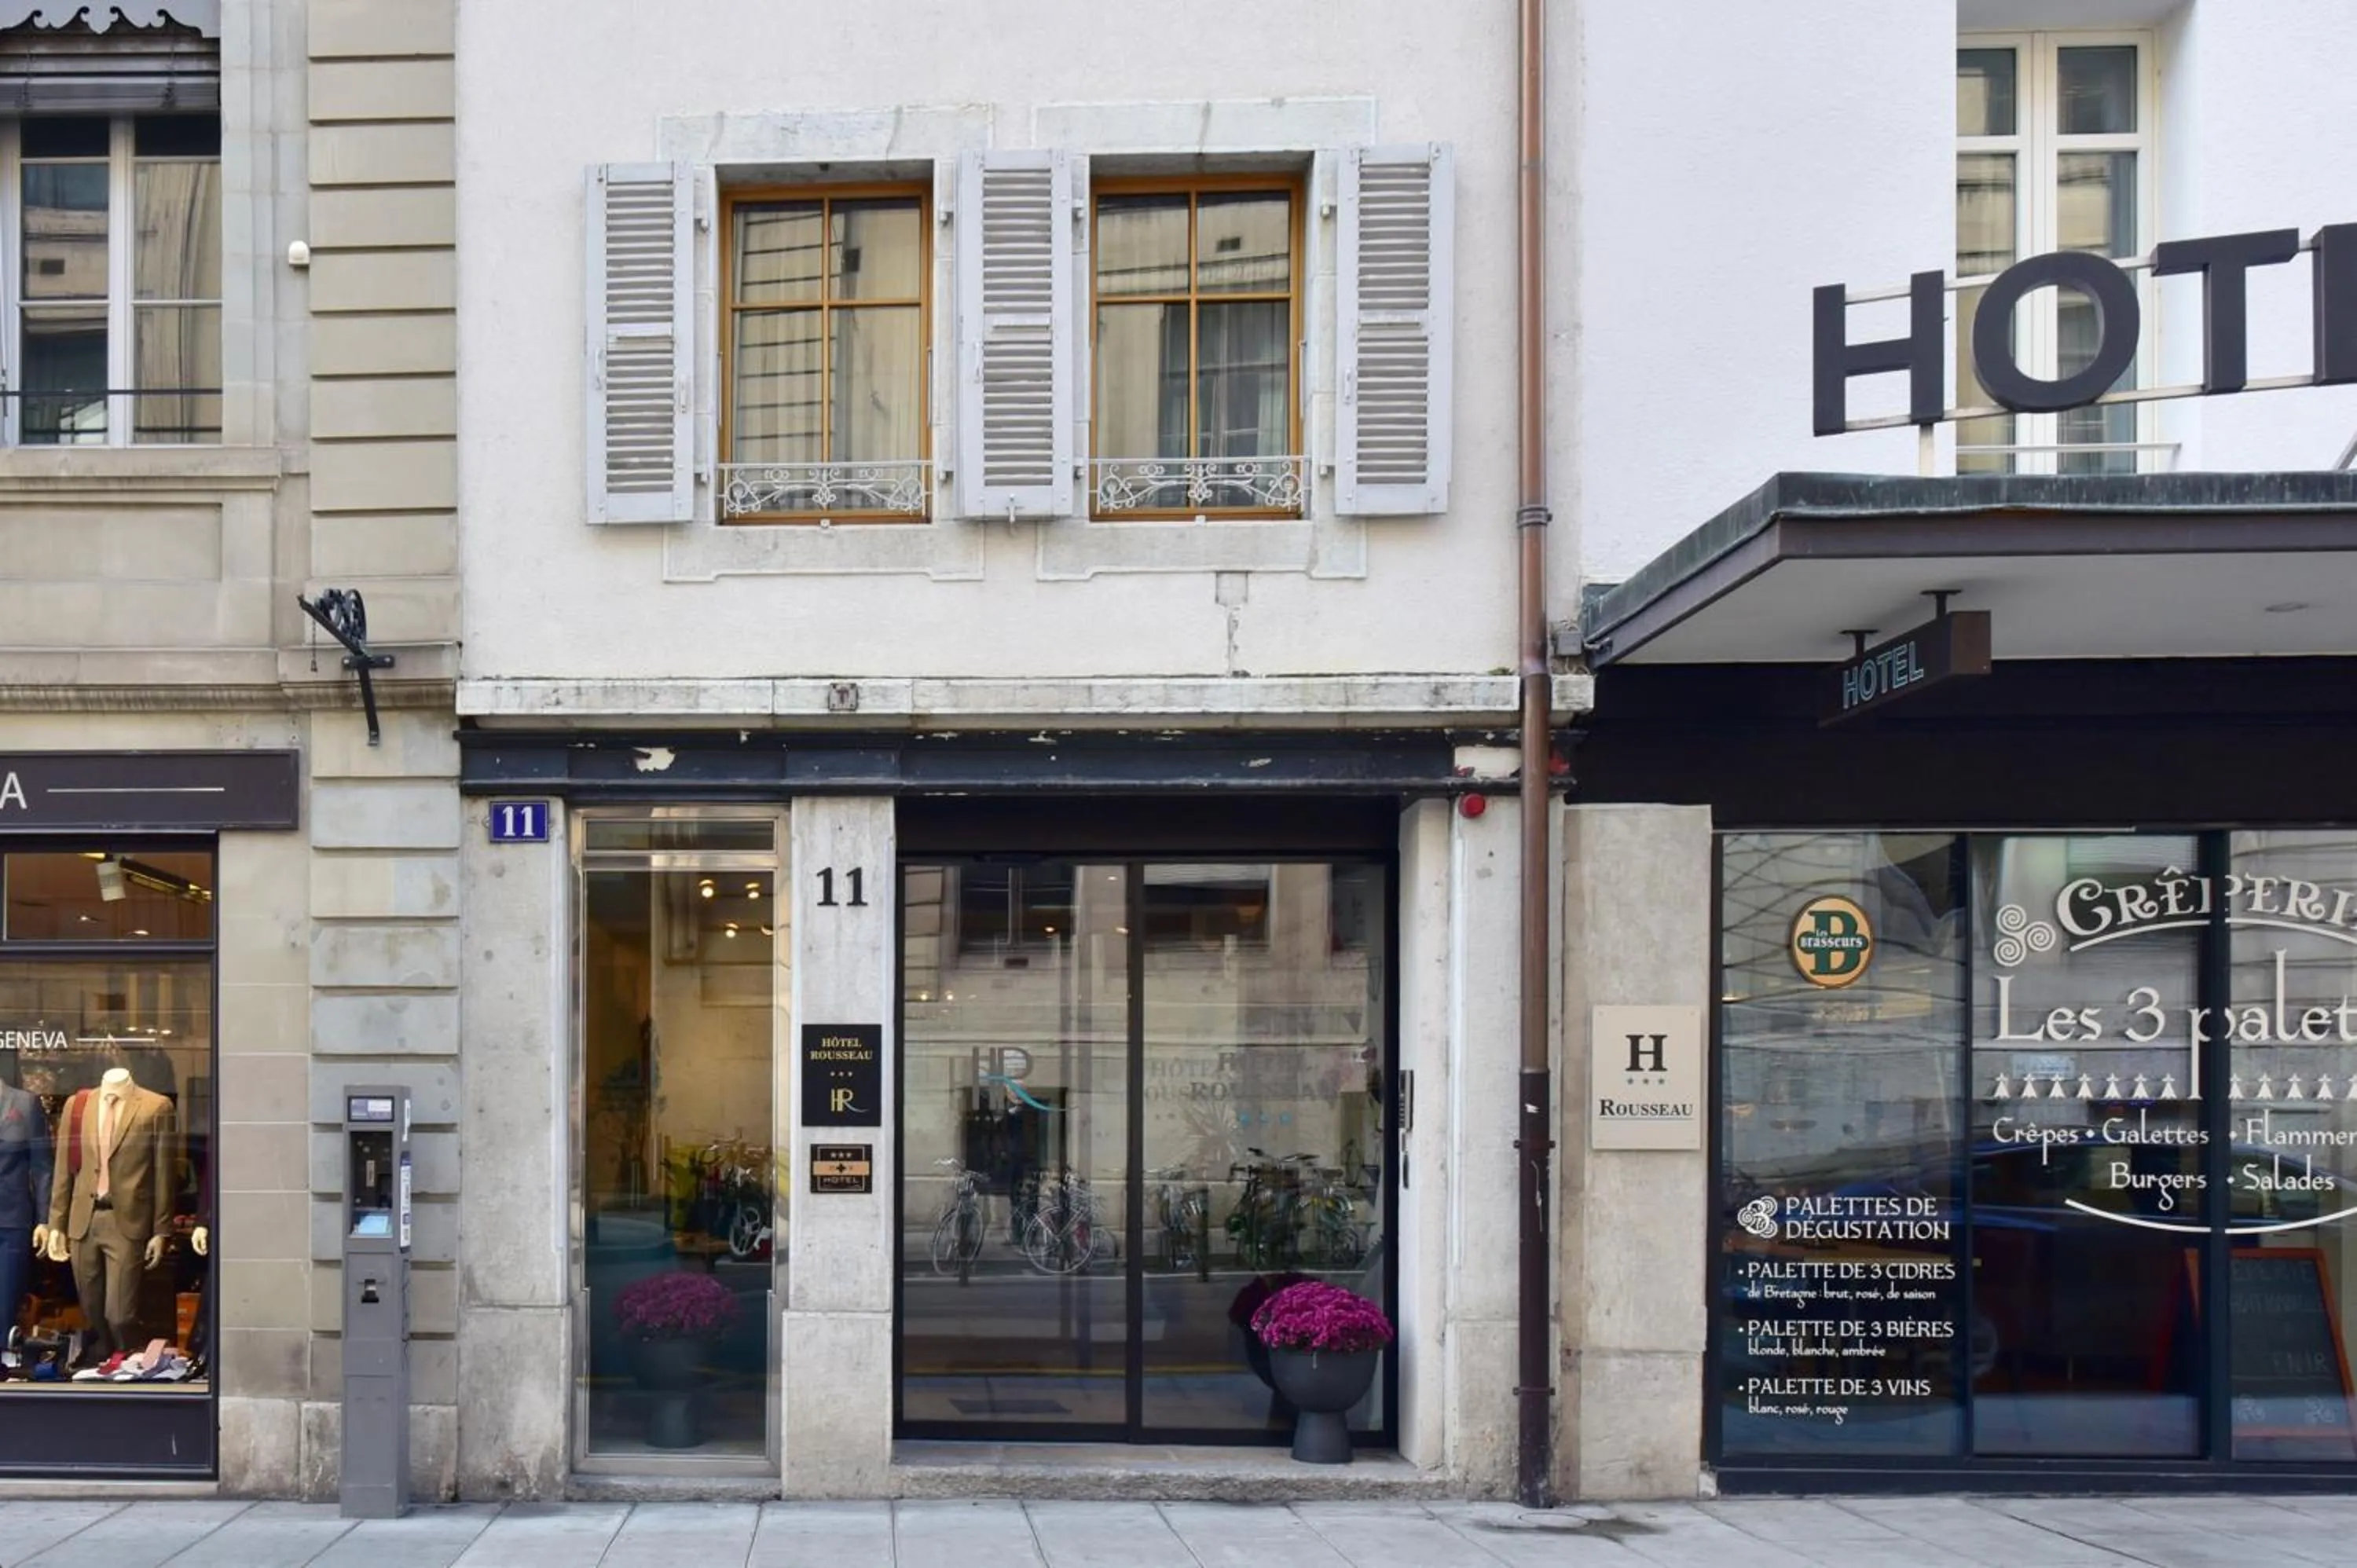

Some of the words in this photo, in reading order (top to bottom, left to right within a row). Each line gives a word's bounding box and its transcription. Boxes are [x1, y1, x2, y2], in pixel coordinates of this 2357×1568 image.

[1842, 640, 1924, 709] HOTEL
[0, 771, 27, 810] A
[502, 805, 535, 837] 11
[816, 866, 867, 907] 11
[2055, 866, 2357, 937] CRÊPERI
[1808, 910, 1861, 975] B
[1993, 974, 2103, 1042] Les
[2124, 986, 2165, 1042] 3
[811, 1050, 873, 1060] ROUSSEAU
[822, 1037, 862, 1047] HÔTEL
[1625, 1035, 1668, 1072] H
[830, 1088, 869, 1113] HR
[1992, 1116, 2079, 1167] Crêpes
[2102, 1108, 2209, 1145] Galettes
[2110, 1162, 2207, 1211] Burgers
[2242, 1154, 2335, 1191] Salades
[1786, 1196, 1901, 1215] PALETTES
[1906, 1196, 1938, 1216] DE
[1786, 1215, 1949, 1240] DÉGUSTATION
[1747, 1262, 1835, 1279] PALETTE
[1840, 1262, 1867, 1279] DE
[1870, 1262, 1882, 1279] 3
[1886, 1262, 1956, 1280] CIDRES
[1747, 1281, 1761, 1297] de
[1765, 1285, 1816, 1309] Bretagne
[1824, 1282, 1853, 1300] brut,
[1887, 1282, 1900, 1299] de
[1902, 1288, 1937, 1299] saison
[1747, 1320, 1835, 1336] PALETTE
[1840, 1321, 1867, 1336] DE
[1870, 1321, 1882, 1336] 3
[1886, 1316, 1955, 1338] BIÈRES
[1747, 1339, 1789, 1357] blonde,
[1792, 1339, 1839, 1357] blanche,
[1841, 1339, 1886, 1357] ambrée
[1747, 1378, 1835, 1394] PALETTE
[1840, 1379, 1867, 1395] DE
[1871, 1379, 1882, 1395] 3
[1887, 1379, 1931, 1396] VINS
[1747, 1396, 1783, 1416] blanc,
[1816, 1405, 1848, 1425] rouge
